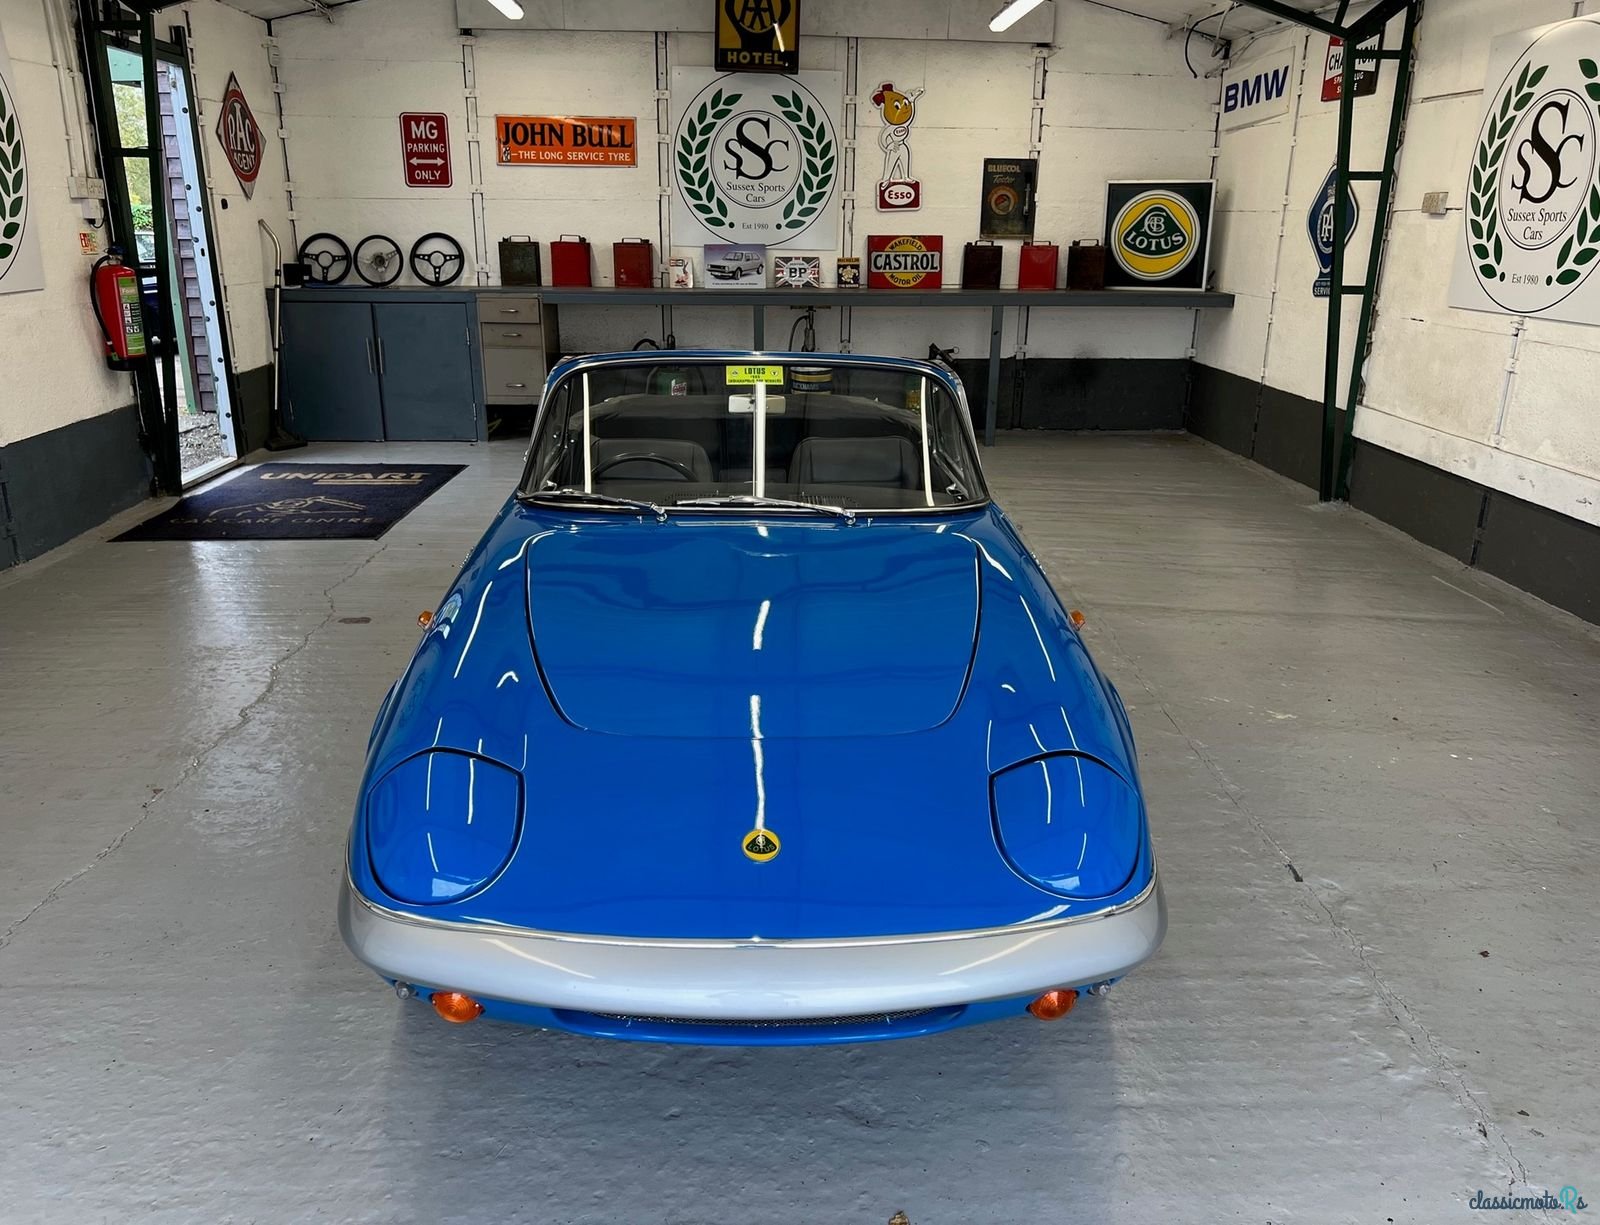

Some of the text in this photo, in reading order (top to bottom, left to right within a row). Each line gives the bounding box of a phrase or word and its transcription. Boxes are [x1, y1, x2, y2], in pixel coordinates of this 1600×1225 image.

[727, 51, 784, 65] HOTEL
[1223, 65, 1290, 114] BMW
[227, 102, 255, 153] RAC
[410, 120, 439, 140] MG
[501, 121, 633, 149] JOHN BULL
[406, 143, 446, 154] PARKING
[233, 152, 256, 171] AGENT
[540, 151, 563, 161] LONG
[567, 151, 604, 162] SERVICE
[608, 152, 631, 162] TYRE
[414, 169, 441, 181] ONLY
[726, 181, 786, 194] Sussex Sports
[745, 193, 766, 203] Cars
[887, 189, 913, 200] Esso
[1507, 207, 1568, 226] Sussex Sports
[741, 222, 769, 230] Est 1980
[1522, 226, 1543, 241] Cars
[888, 238, 923, 251] WAKEFIELD
[1126, 230, 1184, 251] LOTUS
[873, 253, 939, 271] CASTROL
[788, 267, 808, 278] BP
[1511, 273, 1539, 285] Est 1980
[888, 273, 923, 286] MOTOR OIL
[744, 367, 766, 375] LOTUS
[259, 471, 432, 480] UNIPART
